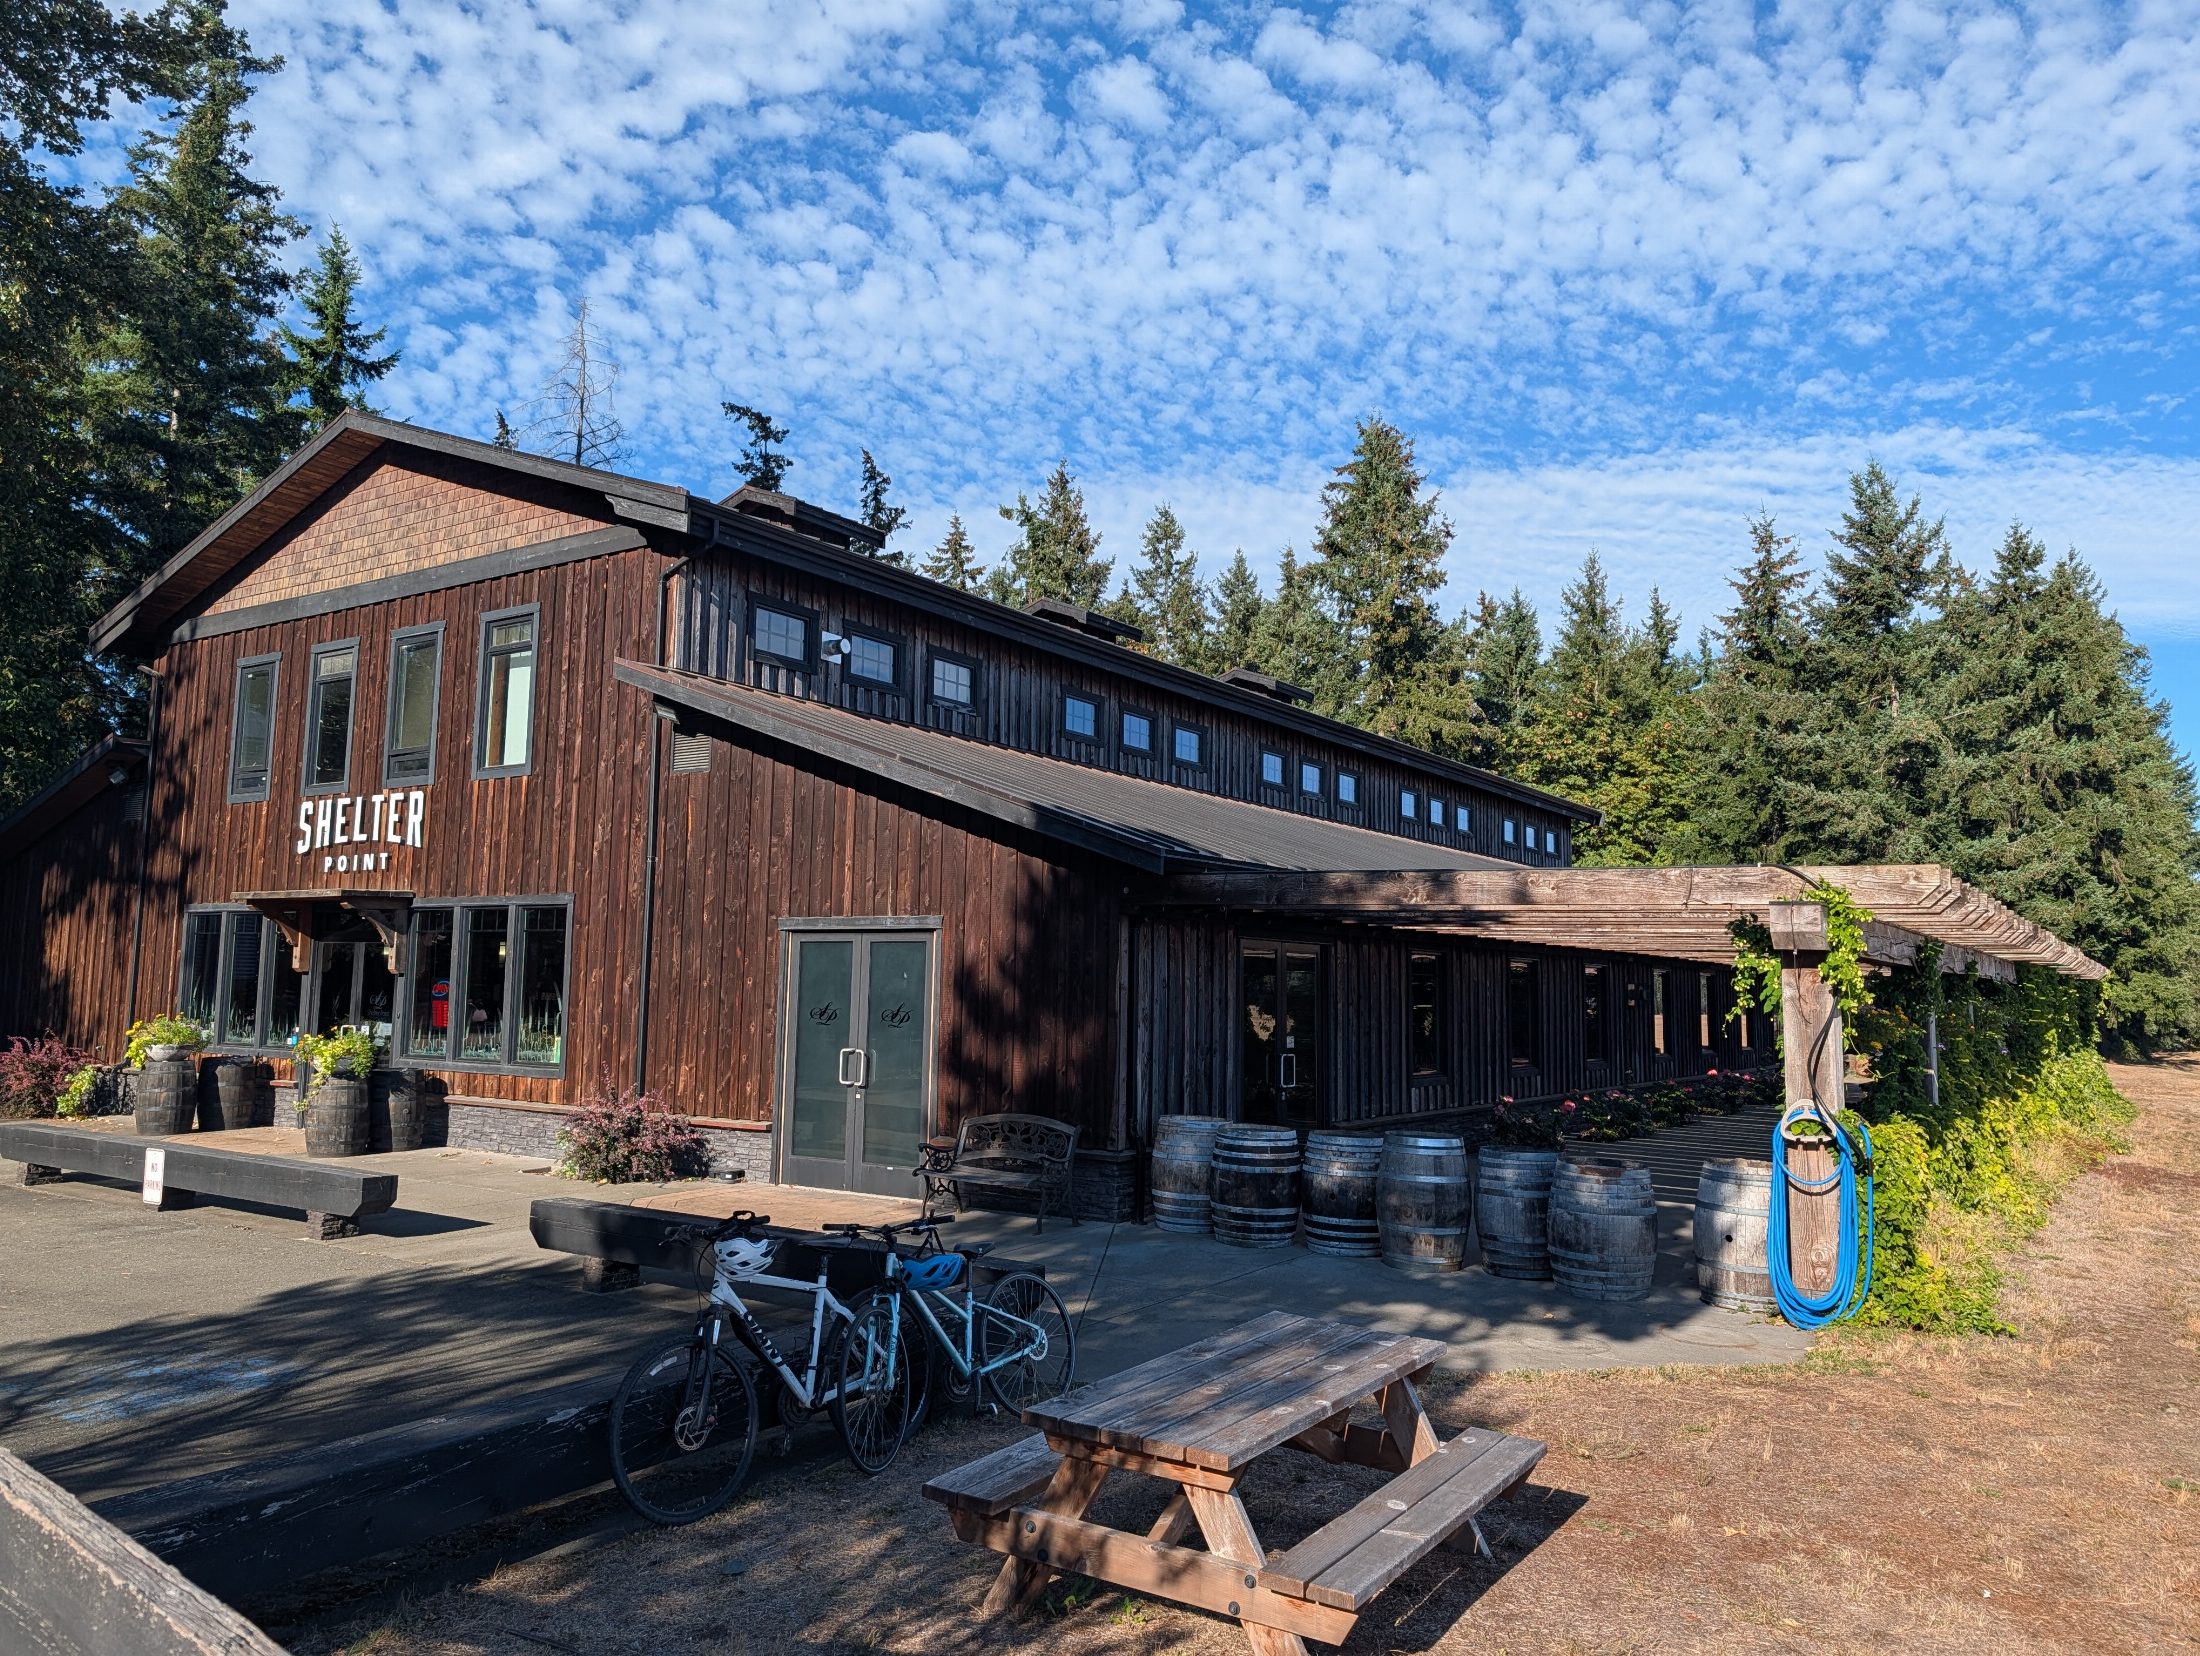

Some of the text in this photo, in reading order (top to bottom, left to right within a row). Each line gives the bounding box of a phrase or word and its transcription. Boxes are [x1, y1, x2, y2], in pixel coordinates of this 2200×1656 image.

[297, 791, 424, 854] SHELTER
[324, 853, 388, 872] POINT
[151, 1162, 158, 1172] NO
